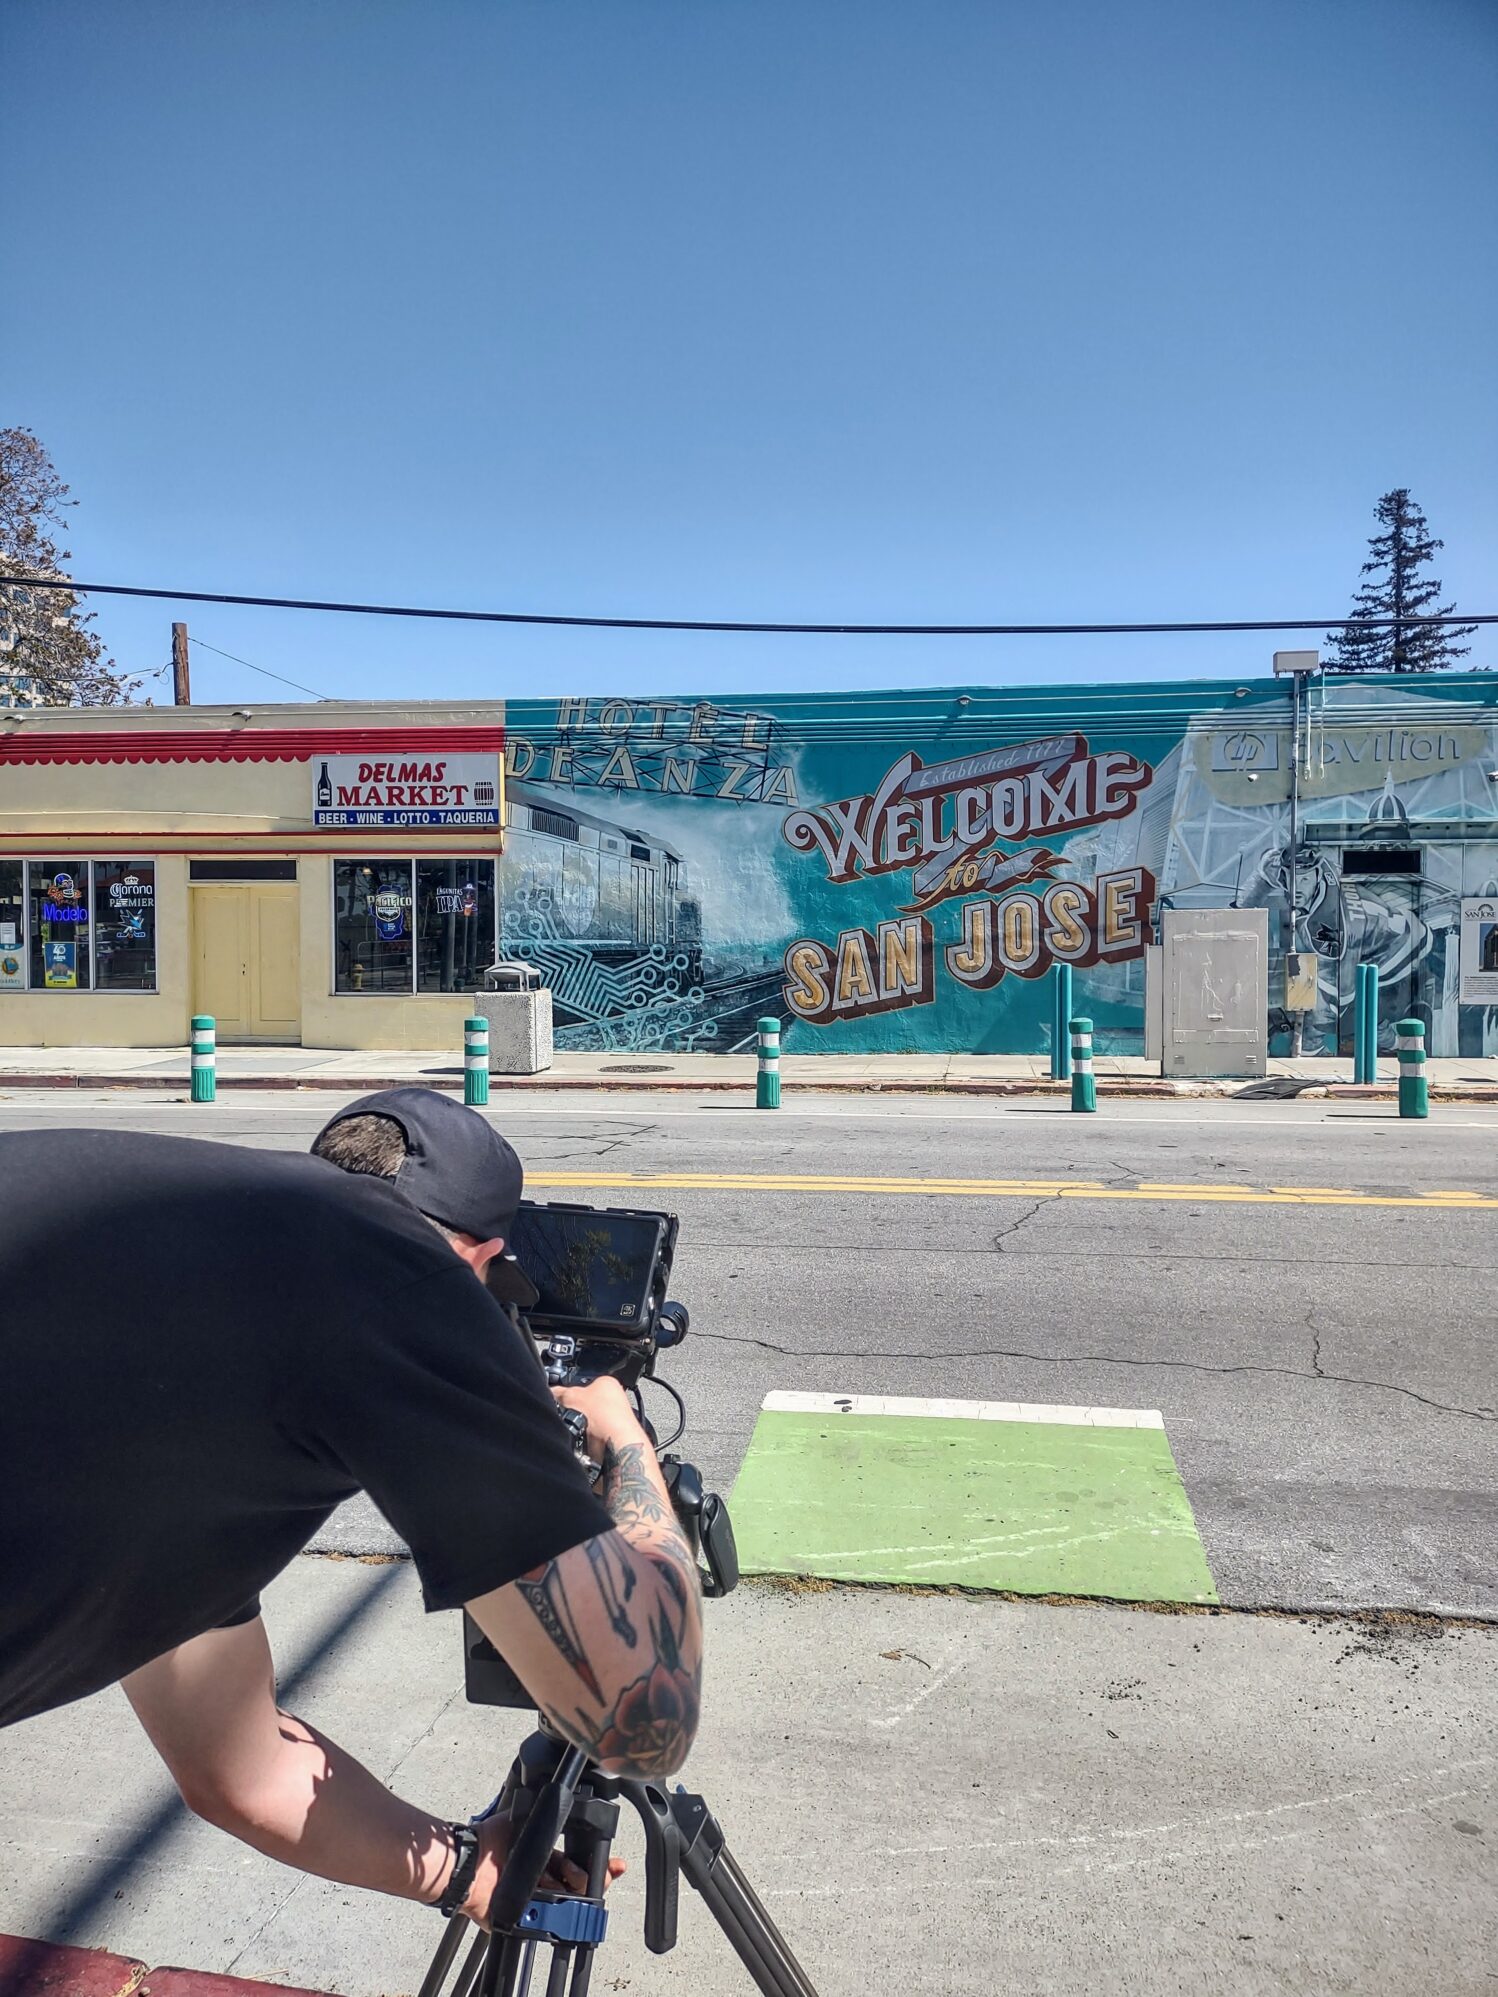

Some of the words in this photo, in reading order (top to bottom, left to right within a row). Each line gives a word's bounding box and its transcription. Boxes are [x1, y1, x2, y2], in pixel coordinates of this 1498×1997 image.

[556, 697, 770, 751] HOTEL
[358, 762, 447, 783] DELMAS
[918, 752, 1021, 788] Established
[1025, 739, 1066, 761] 1777
[336, 785, 469, 807] MARKET
[318, 812, 348, 824] BEER
[356, 812, 385, 824] WINE
[393, 812, 431, 824] LOTTO
[439, 811, 495, 824] TAQUERIA
[783, 751, 1150, 881] WELCOME
[109, 883, 153, 898] Corona
[436, 886, 464, 896] LAGUNITAS
[366, 895, 412, 908] PACIFICO
[435, 895, 464, 914] IPA
[43, 903, 89, 922] Modelo
[1480, 910, 1496, 919] JOSE
[784, 915, 932, 1024] SAN
[946, 867, 1152, 988] JOSE
